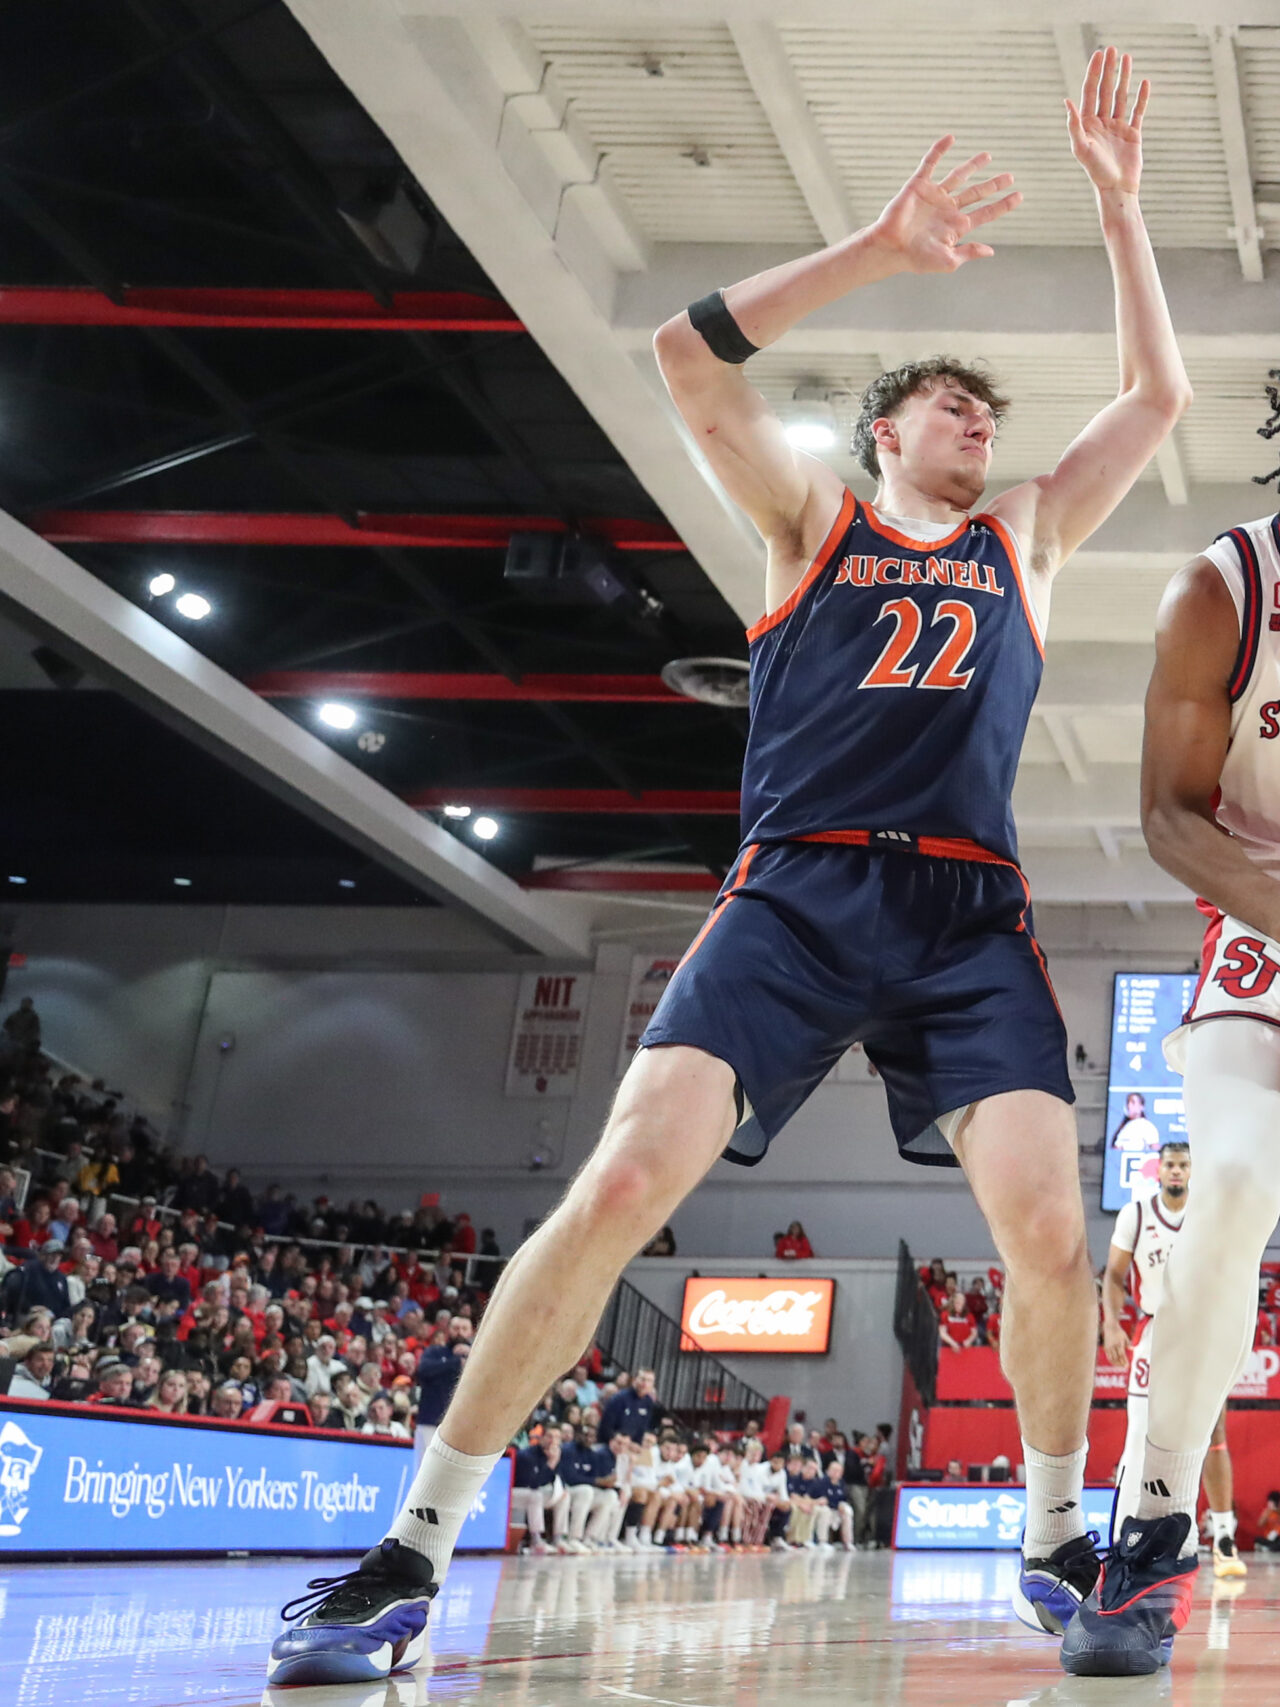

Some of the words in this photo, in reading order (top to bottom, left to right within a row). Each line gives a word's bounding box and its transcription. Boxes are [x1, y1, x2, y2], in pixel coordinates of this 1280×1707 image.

[832, 554, 1005, 597] BUCKNELL
[857, 596, 977, 690] 22
[533, 975, 577, 1008] NIT
[64, 1456, 169, 1519] Bringing
[169, 1462, 223, 1508] New
[225, 1466, 298, 1510] Yorkers
[301, 1470, 380, 1523] Together
[907, 1495, 990, 1528] Stout
